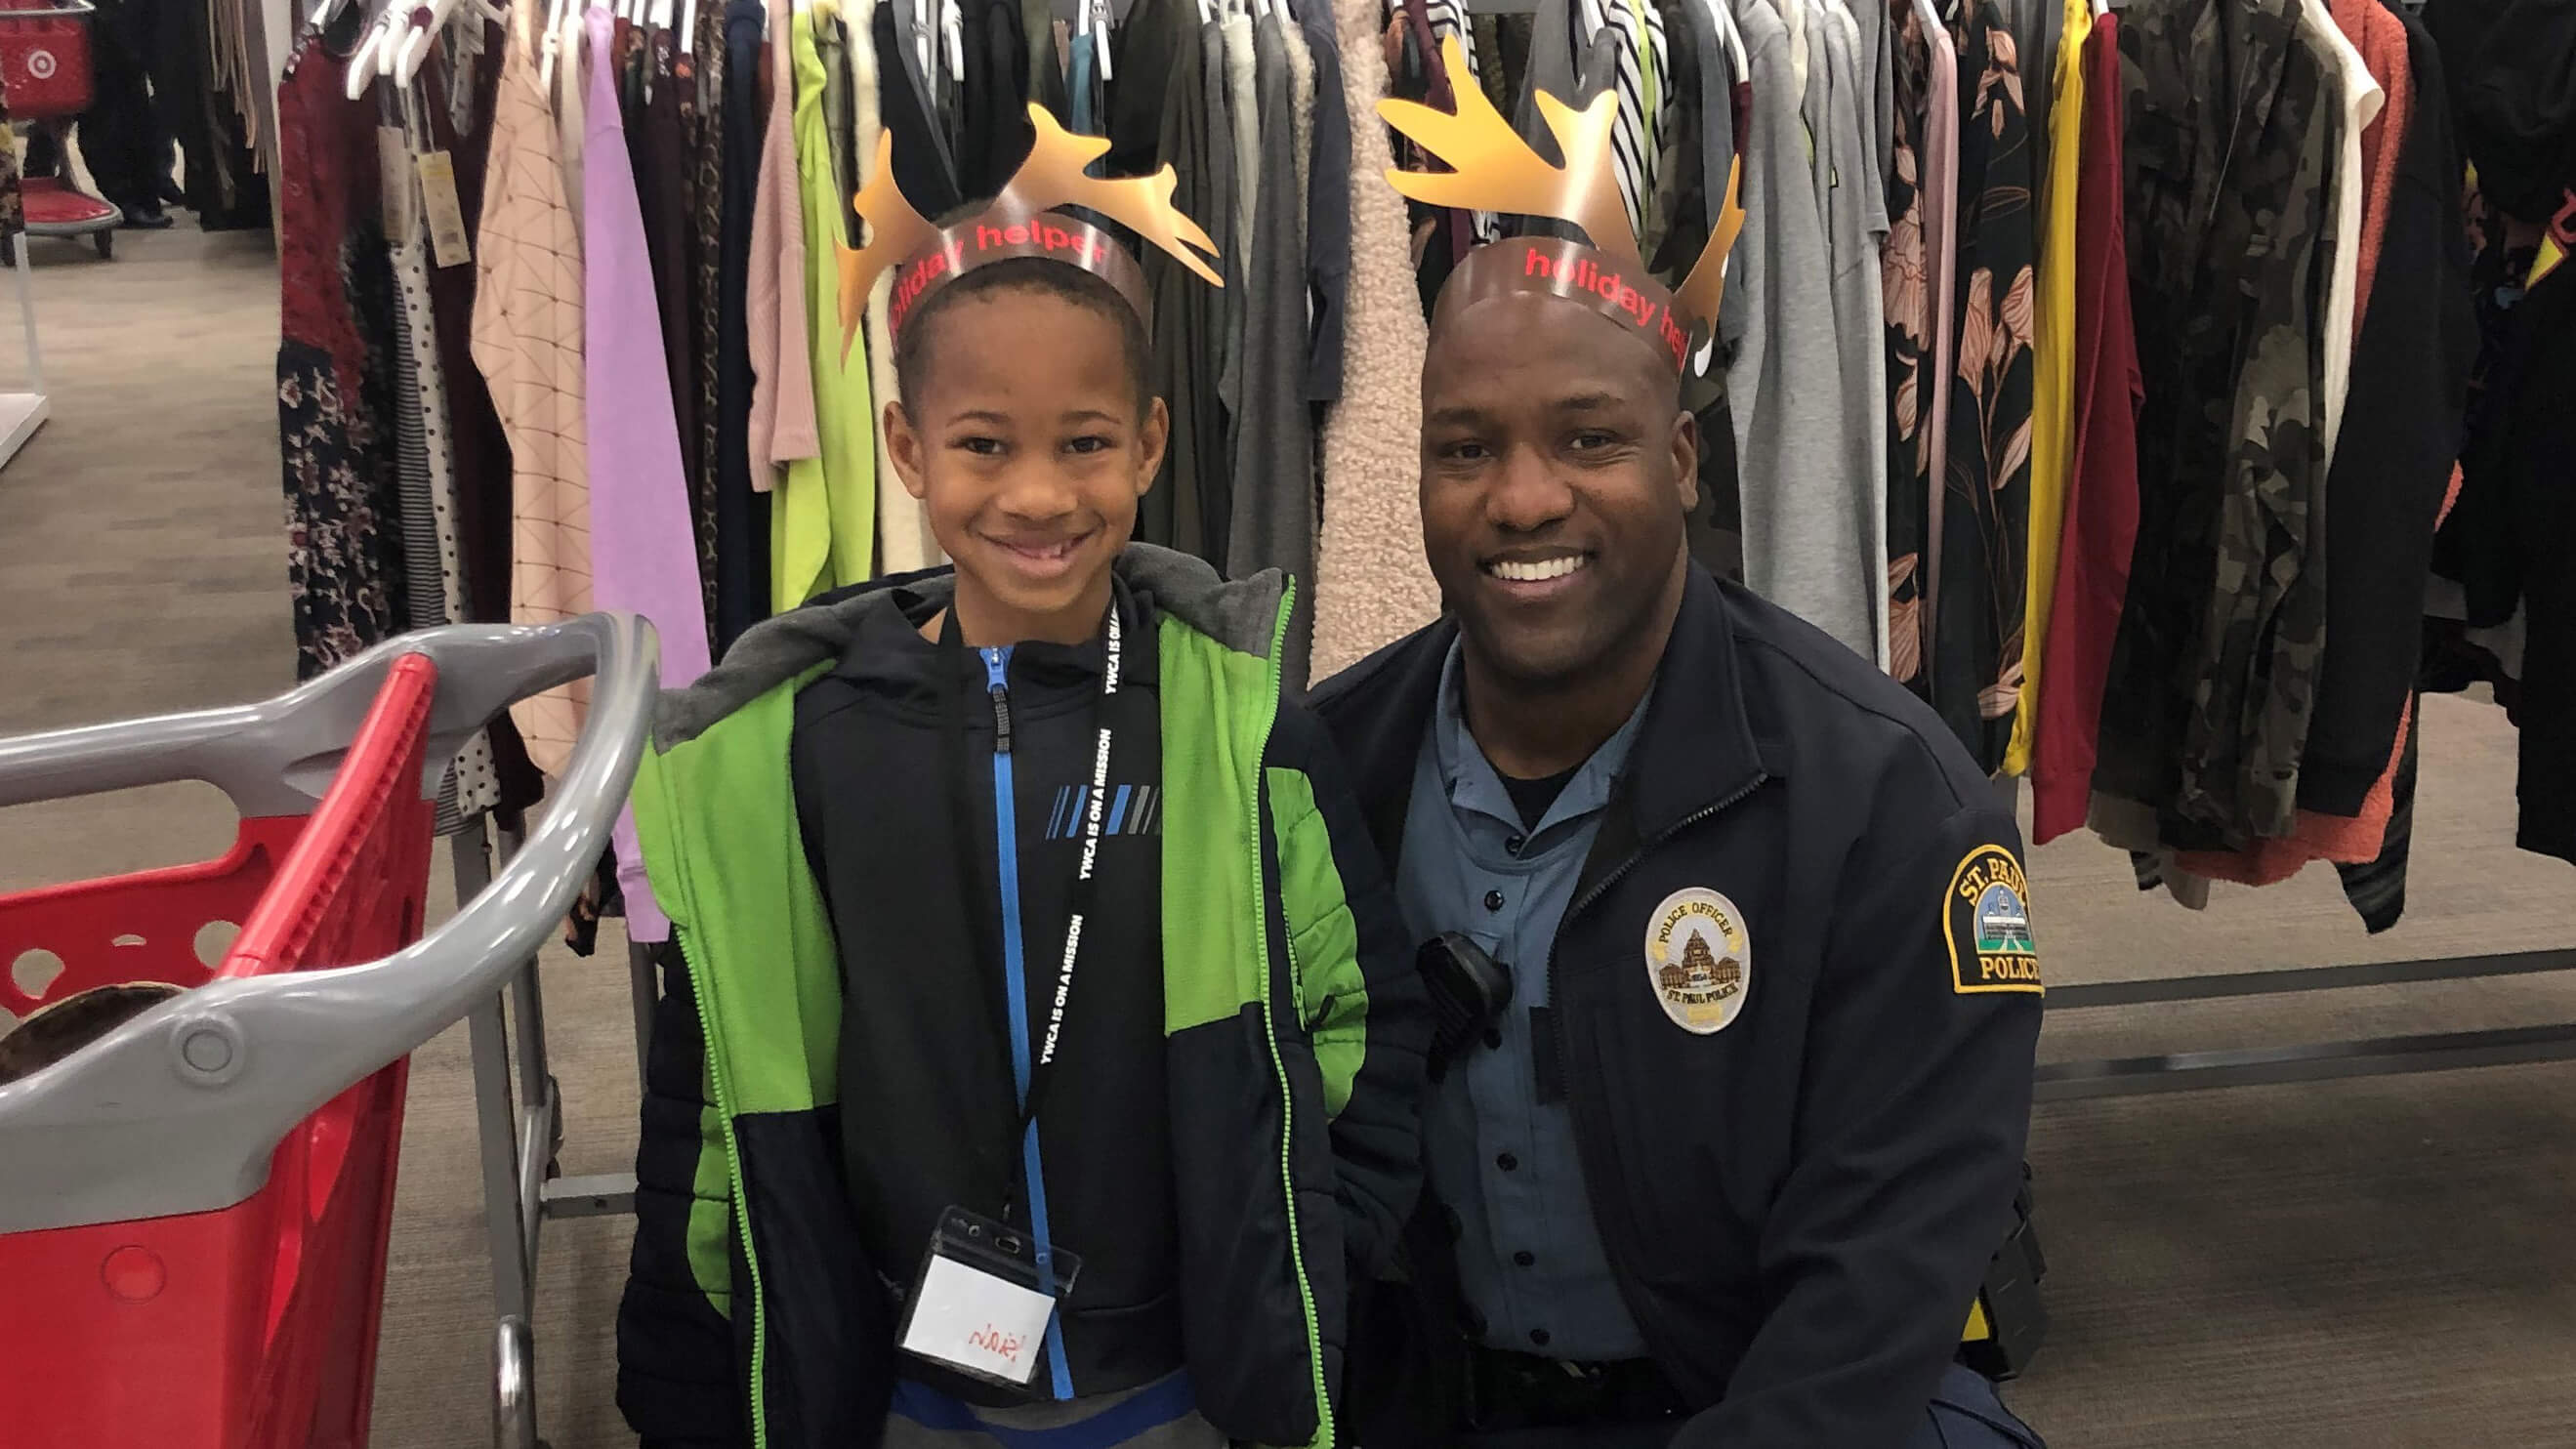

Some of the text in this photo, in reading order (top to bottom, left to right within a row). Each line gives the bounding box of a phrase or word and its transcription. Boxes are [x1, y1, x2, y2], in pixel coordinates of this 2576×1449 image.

[976, 219, 1105, 262] helper
[1524, 247, 1657, 327] holiday
[1108, 640, 1121, 653] IS
[1105, 654, 1120, 694] YWCA
[1079, 728, 1112, 880] YWCA IS ON A MISSION
[1987, 858, 2026, 907] PAUL
[1659, 902, 1732, 944] POLICE OFFICER
[1040, 914, 1084, 1064] YWCA IS ON A MISSION
[1682, 993, 1705, 1005] PAUL
[1706, 983, 1739, 1003] POLICE
